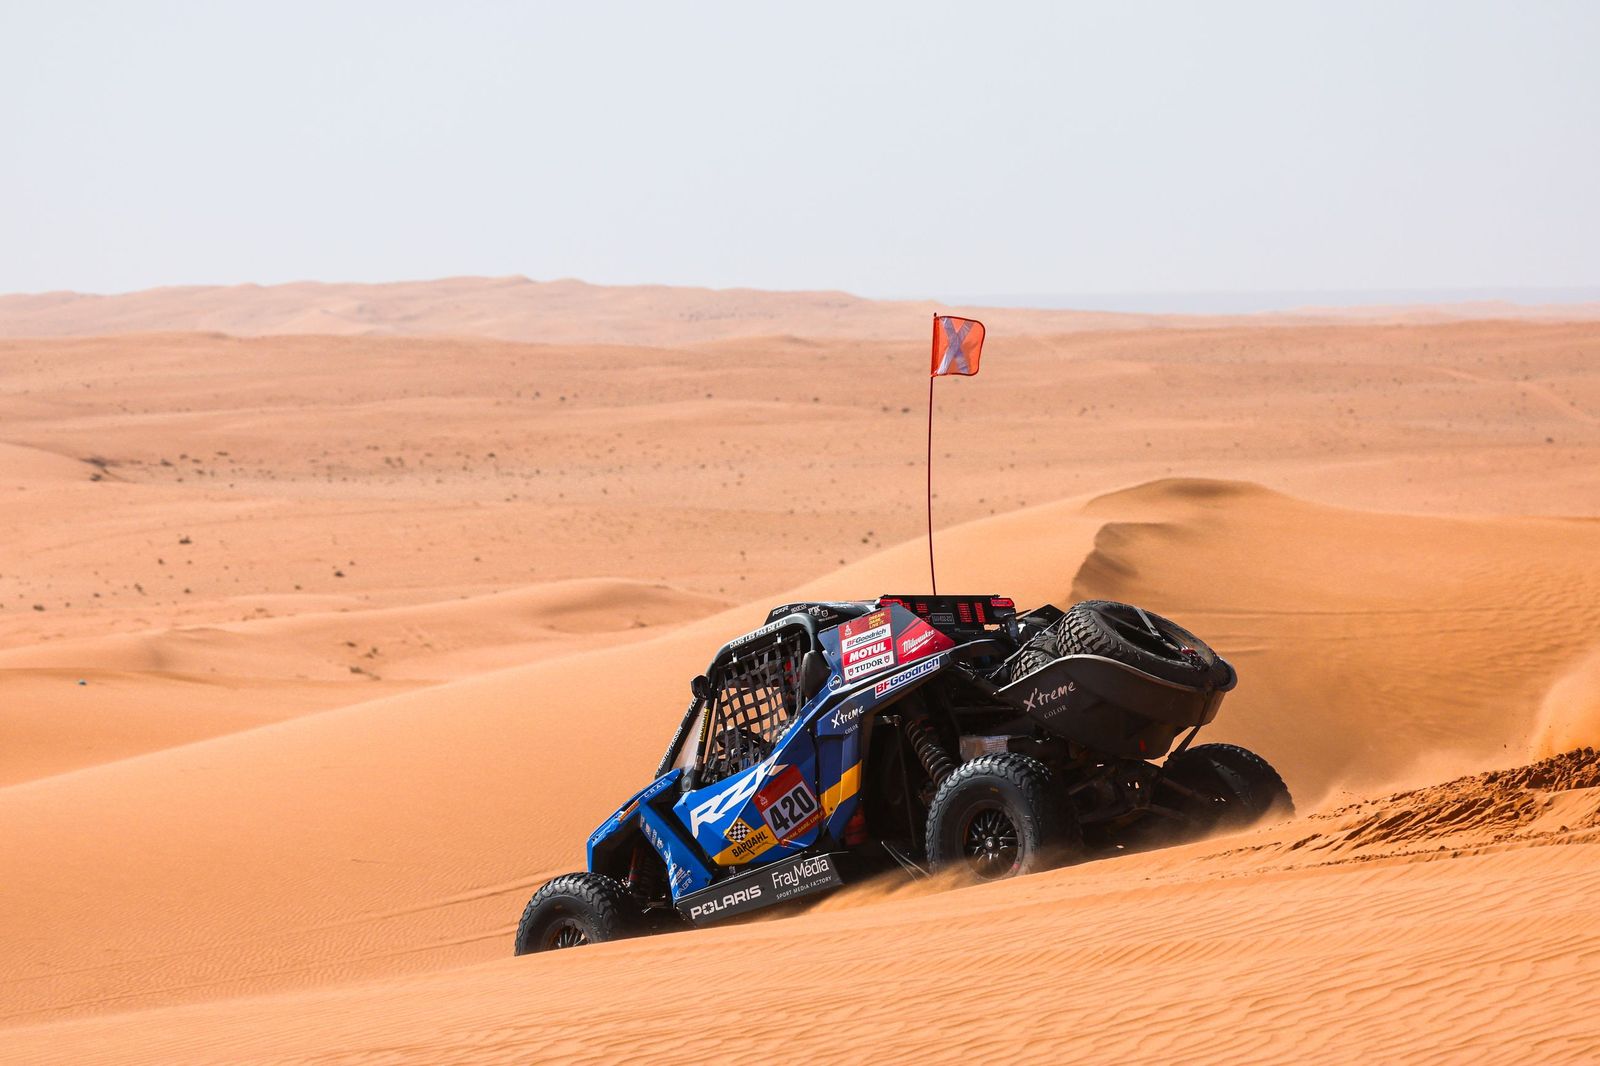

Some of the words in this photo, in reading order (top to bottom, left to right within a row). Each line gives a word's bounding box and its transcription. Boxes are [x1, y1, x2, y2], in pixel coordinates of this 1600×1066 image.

[846, 628, 887, 647] BFGoodrich
[849, 642, 887, 663] MOTUL
[855, 657, 883, 673] TUDOR
[876, 657, 939, 694] BFGoodrich
[769, 786, 816, 832] 420
[731, 830, 769, 858] BARDAHL
[771, 857, 830, 889] FrayMédia
[776, 890, 792, 900] SPORT
[810, 876, 832, 888] FACTORY
[690, 885, 762, 920] POLARIS
